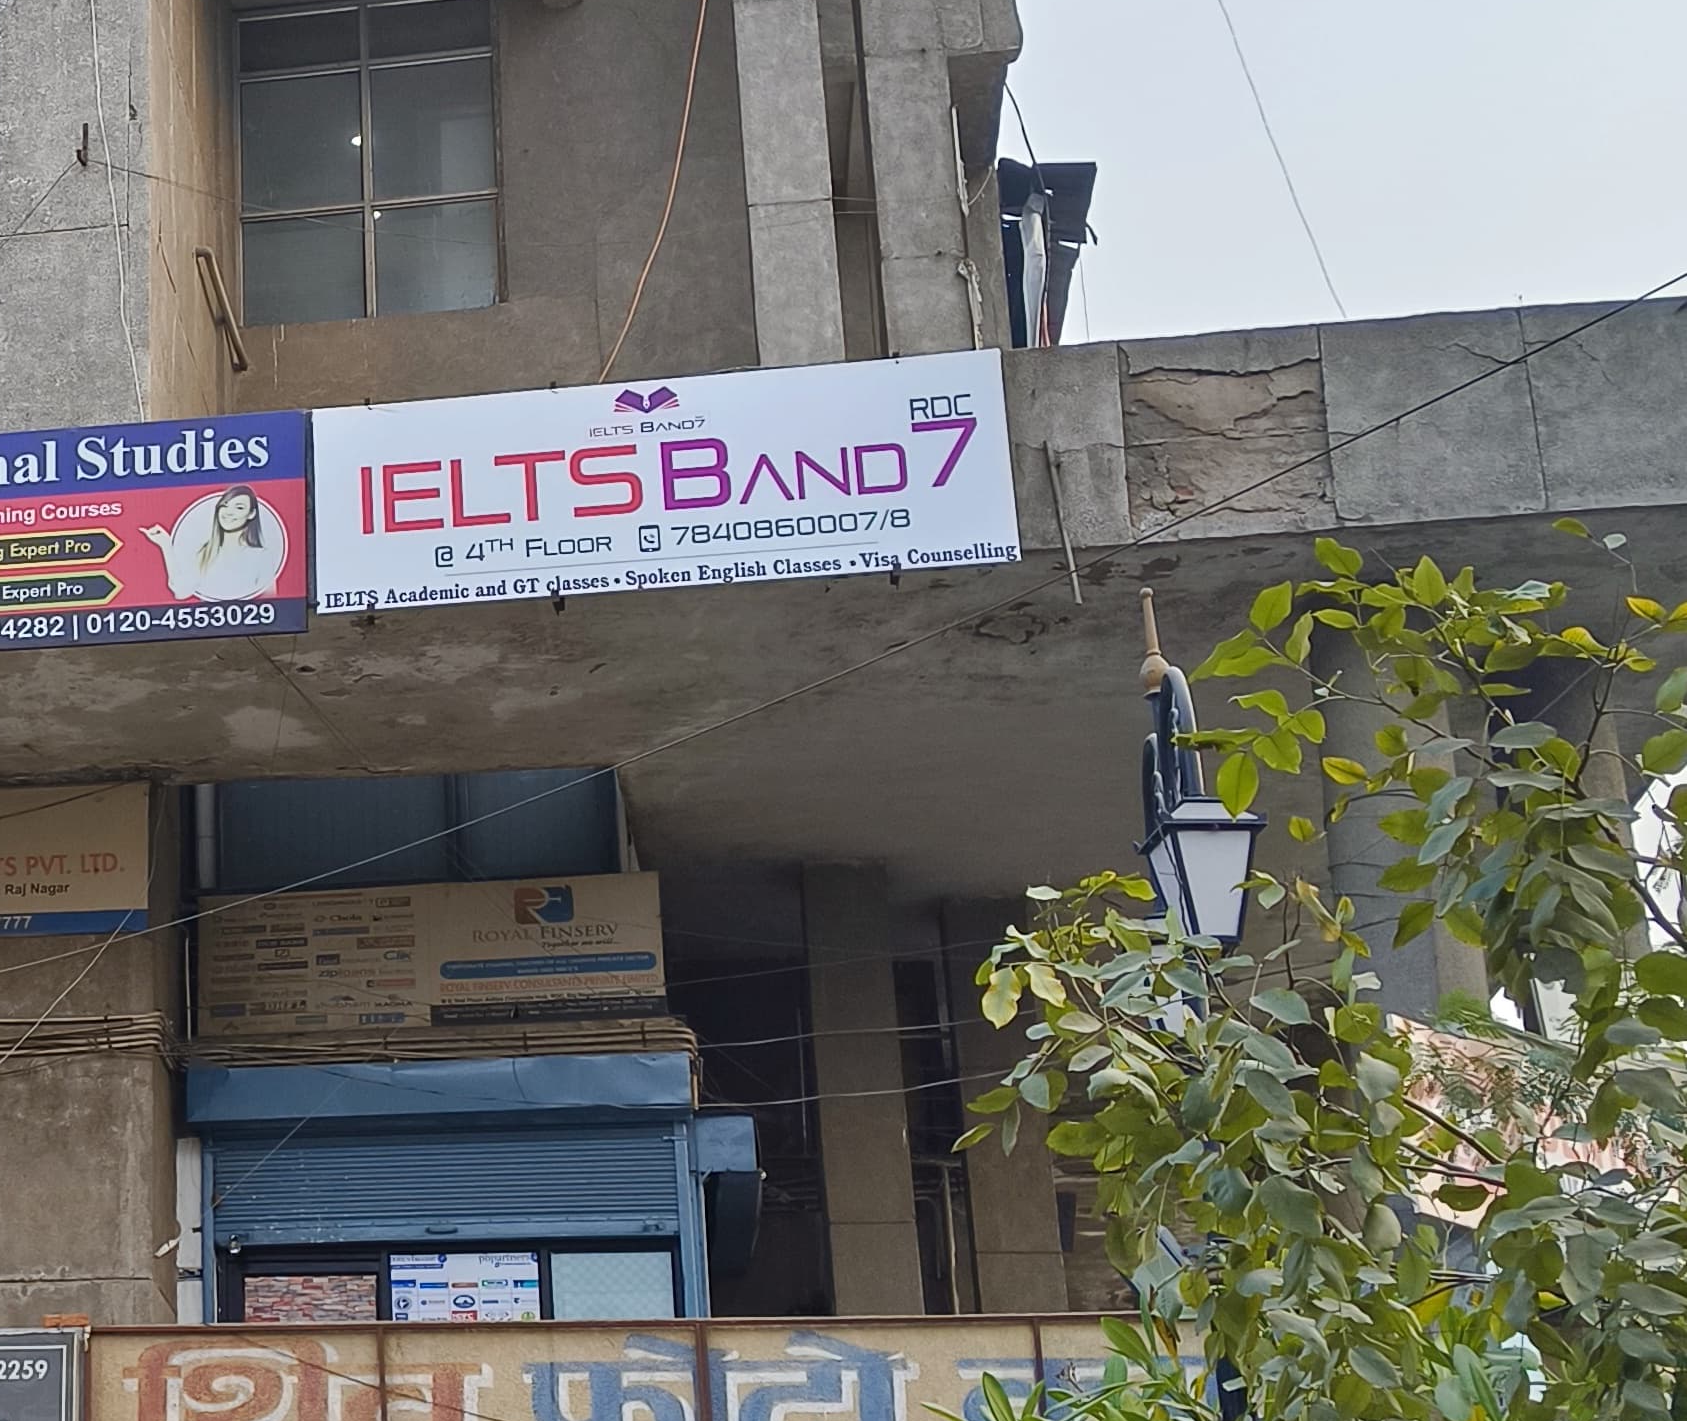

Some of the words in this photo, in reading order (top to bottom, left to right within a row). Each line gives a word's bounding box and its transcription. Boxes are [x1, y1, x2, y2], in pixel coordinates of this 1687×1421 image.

[910, 394, 973, 420] RDC
[76, 428, 270, 480] Studies
[360, 444, 644, 535] IELTS
[40, 501, 122, 521] Courses
[671, 508, 911, 546] 7840860007/8
[435, 545, 454, 568] @
[464, 538, 514, 562] 4TH
[525, 535, 613, 558] FLOOR
[3, 582, 52, 602] Expert
[56, 580, 84, 597] Pro
[324, 591, 379, 609] IELTS
[385, 582, 471, 605] Academic
[475, 578, 508, 598] and
[513, 576, 540, 595] GT
[547, 573, 609, 592] classes
[625, 566, 692, 589] Spoken
[698, 559, 768, 582] English
[773, 555, 841, 576] Classes
[860, 550, 902, 570] Visa
[907, 542, 1018, 567] Counselling
[86, 605, 276, 636] 0120-4553029
[25, 855, 72, 877] PVT.
[81, 852, 125, 874] LTD.
